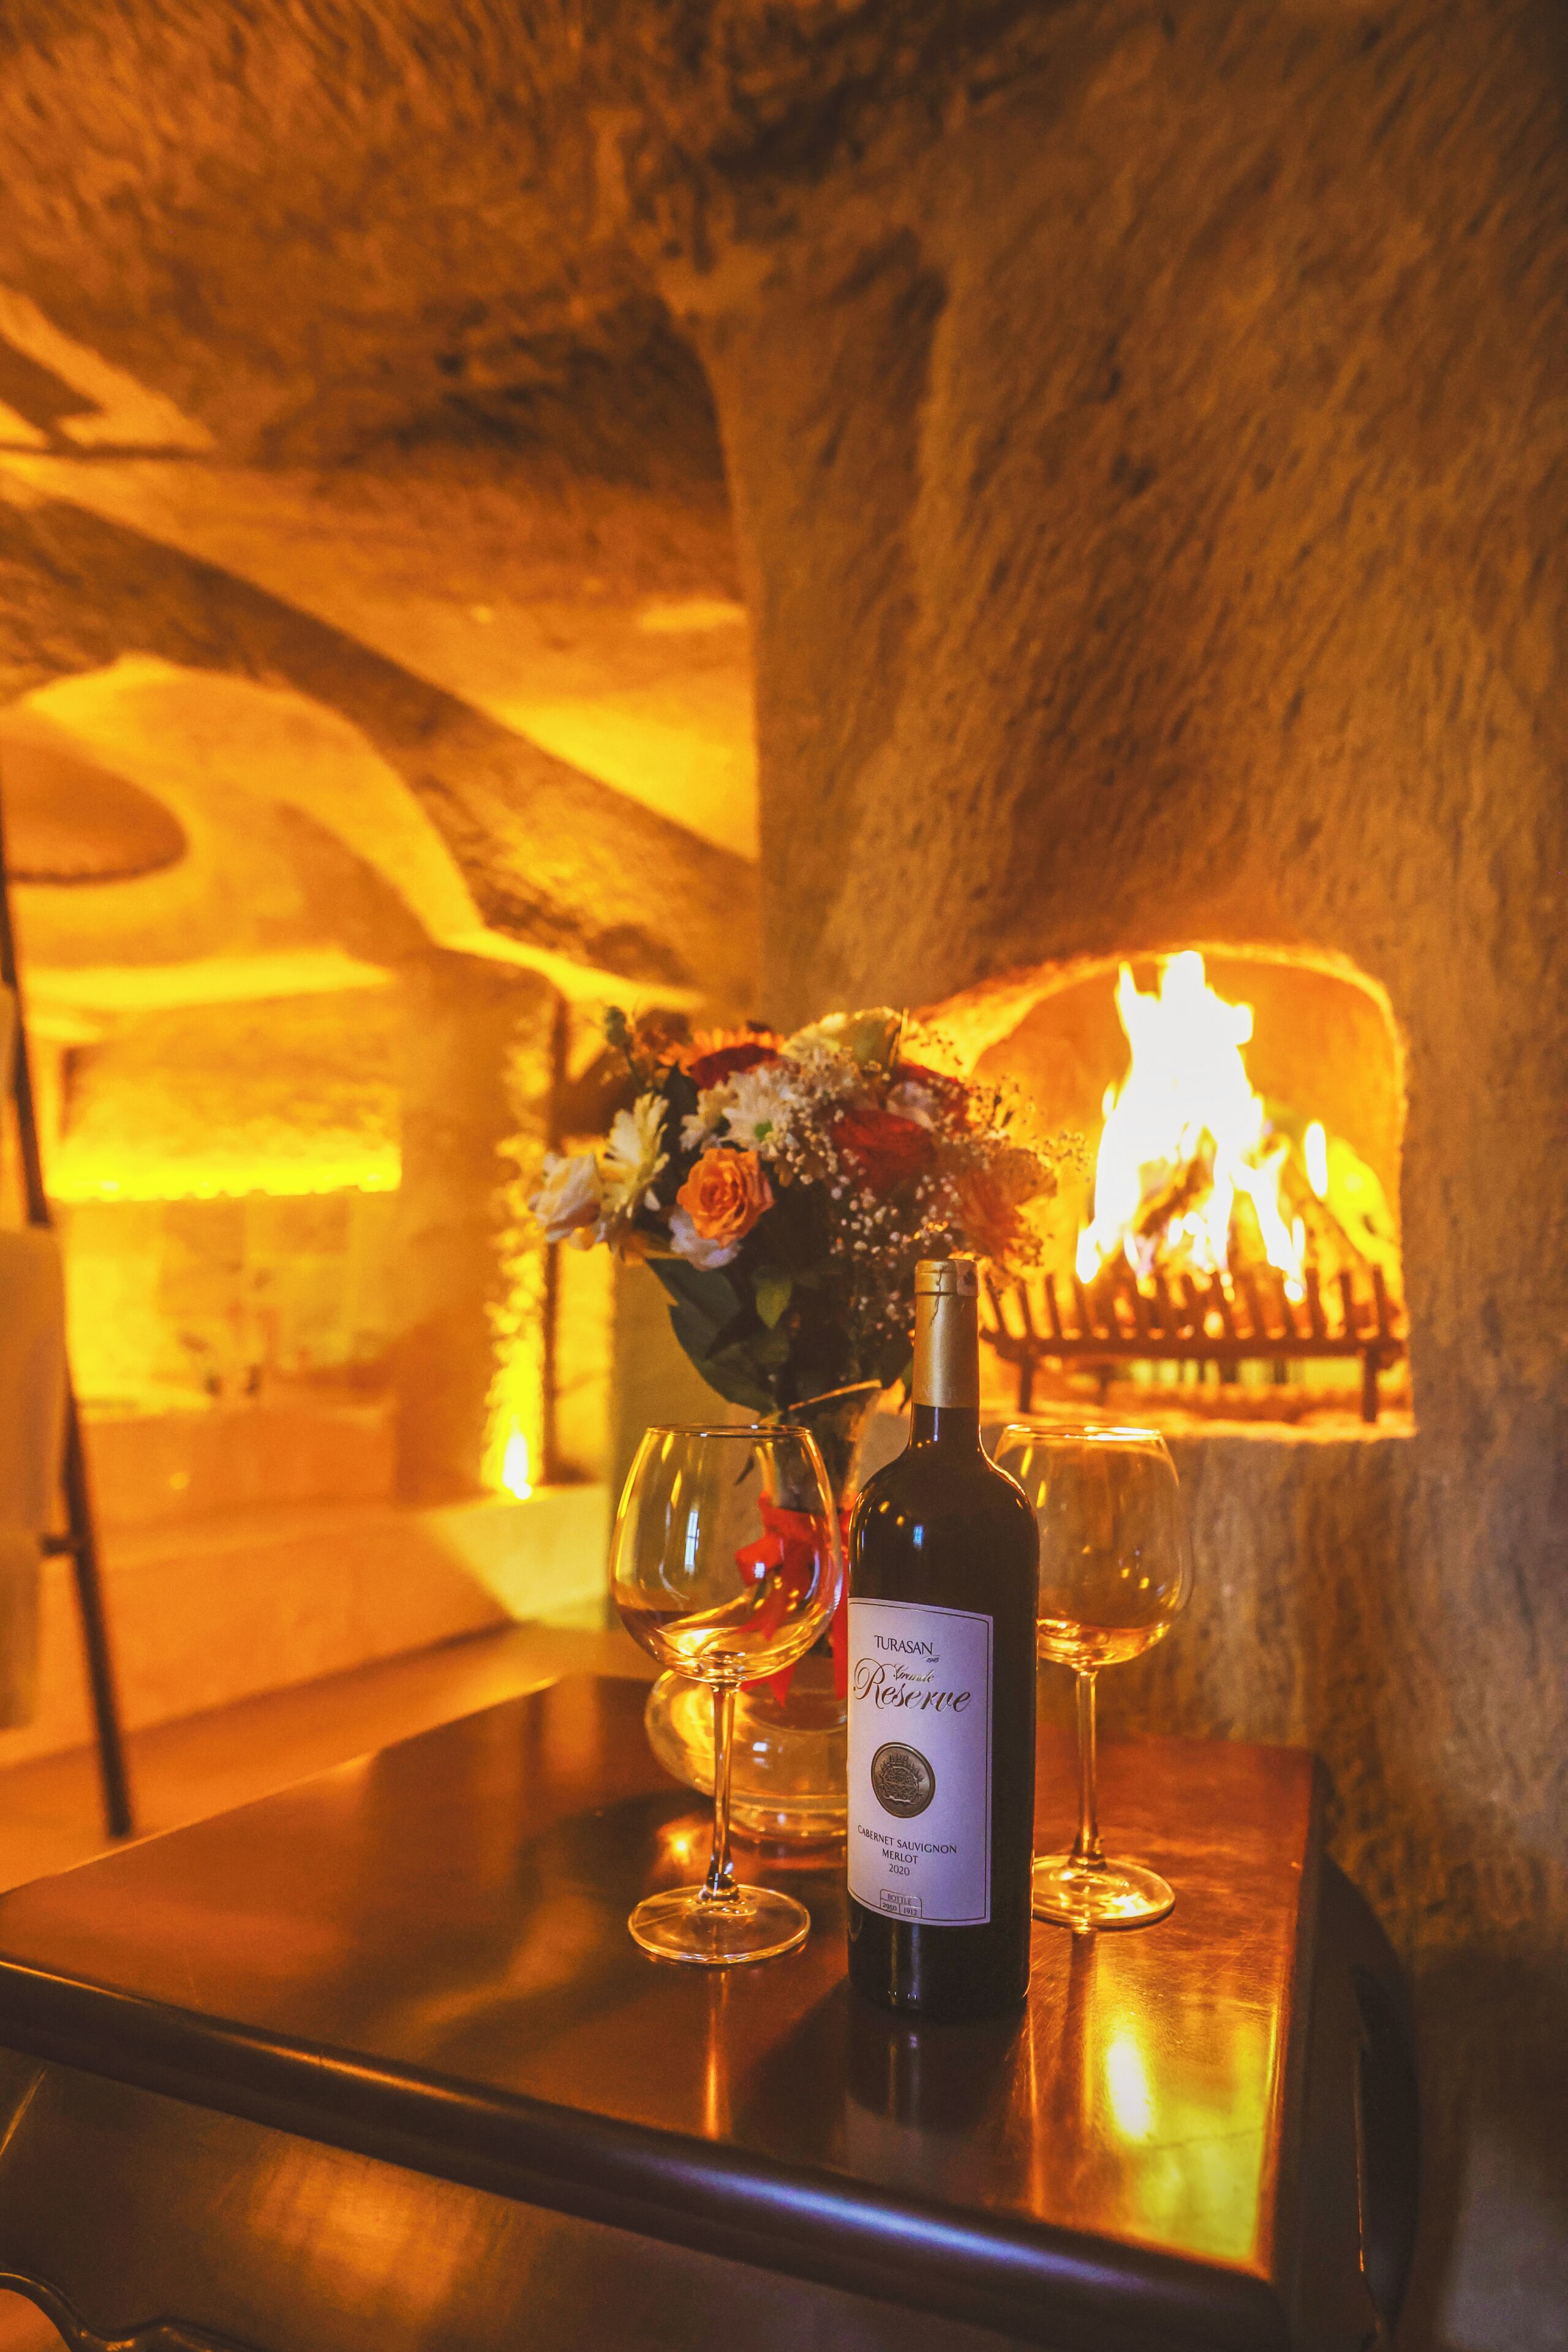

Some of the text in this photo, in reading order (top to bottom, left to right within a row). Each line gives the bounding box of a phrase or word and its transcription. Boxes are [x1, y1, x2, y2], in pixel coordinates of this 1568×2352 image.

[874, 1635, 933, 1655] TURASAN
[893, 1663, 935, 1683] Grande
[853, 1657, 971, 1713] Reserve
[858, 1825, 957, 1854] CABERNET SAUVIGNON
[882, 1848, 919, 1864] MERLOT
[889, 1863, 910, 1876] 2020
[888, 1893, 912, 1905] BOTTLE
[903, 1907, 918, 1916] 1912
